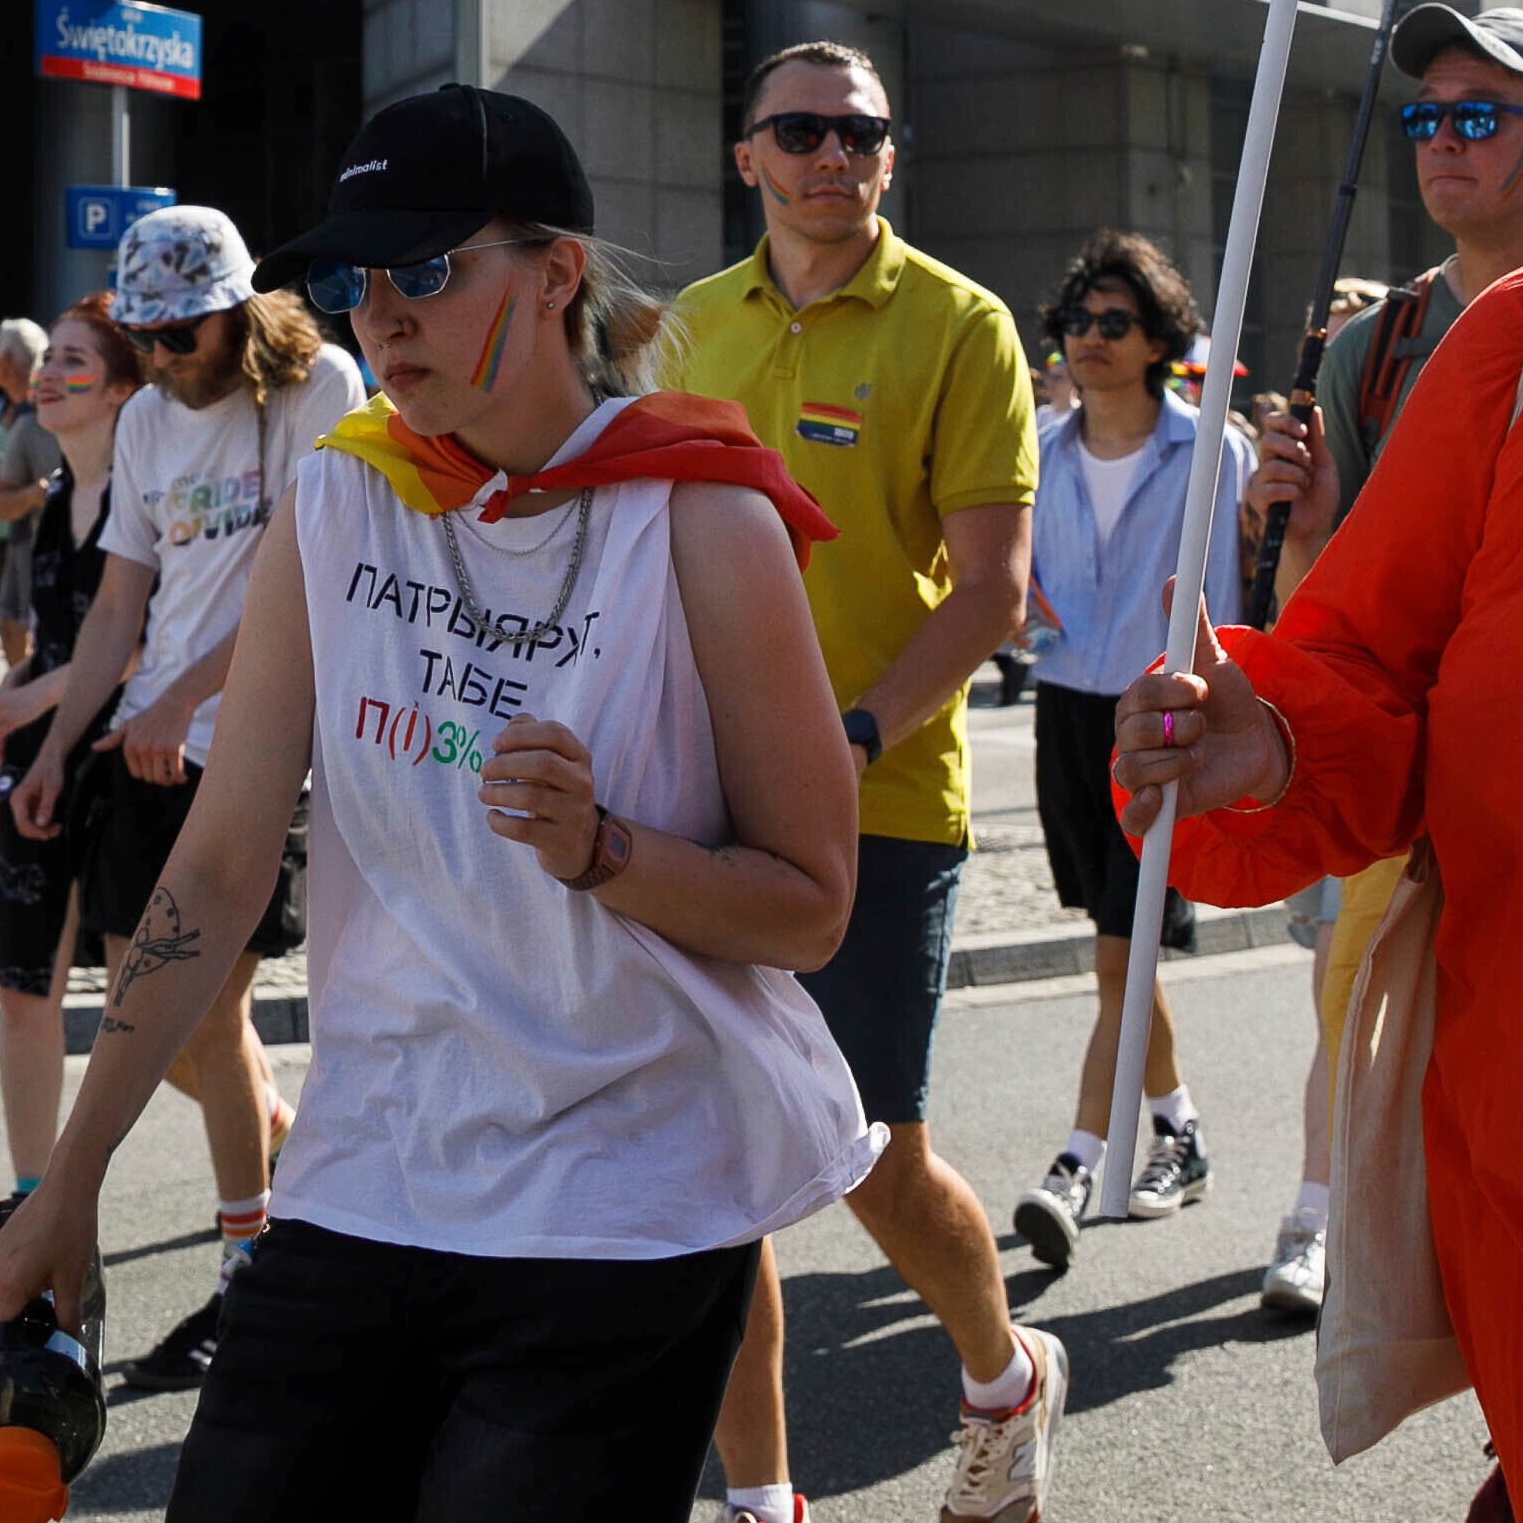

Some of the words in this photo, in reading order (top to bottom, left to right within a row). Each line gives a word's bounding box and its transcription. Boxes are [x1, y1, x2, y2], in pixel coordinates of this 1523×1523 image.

[55, 6, 193, 71] Świętokrzyska
[85, 204, 107, 232] P
[419, 649, 528, 720] ТАБЕ
